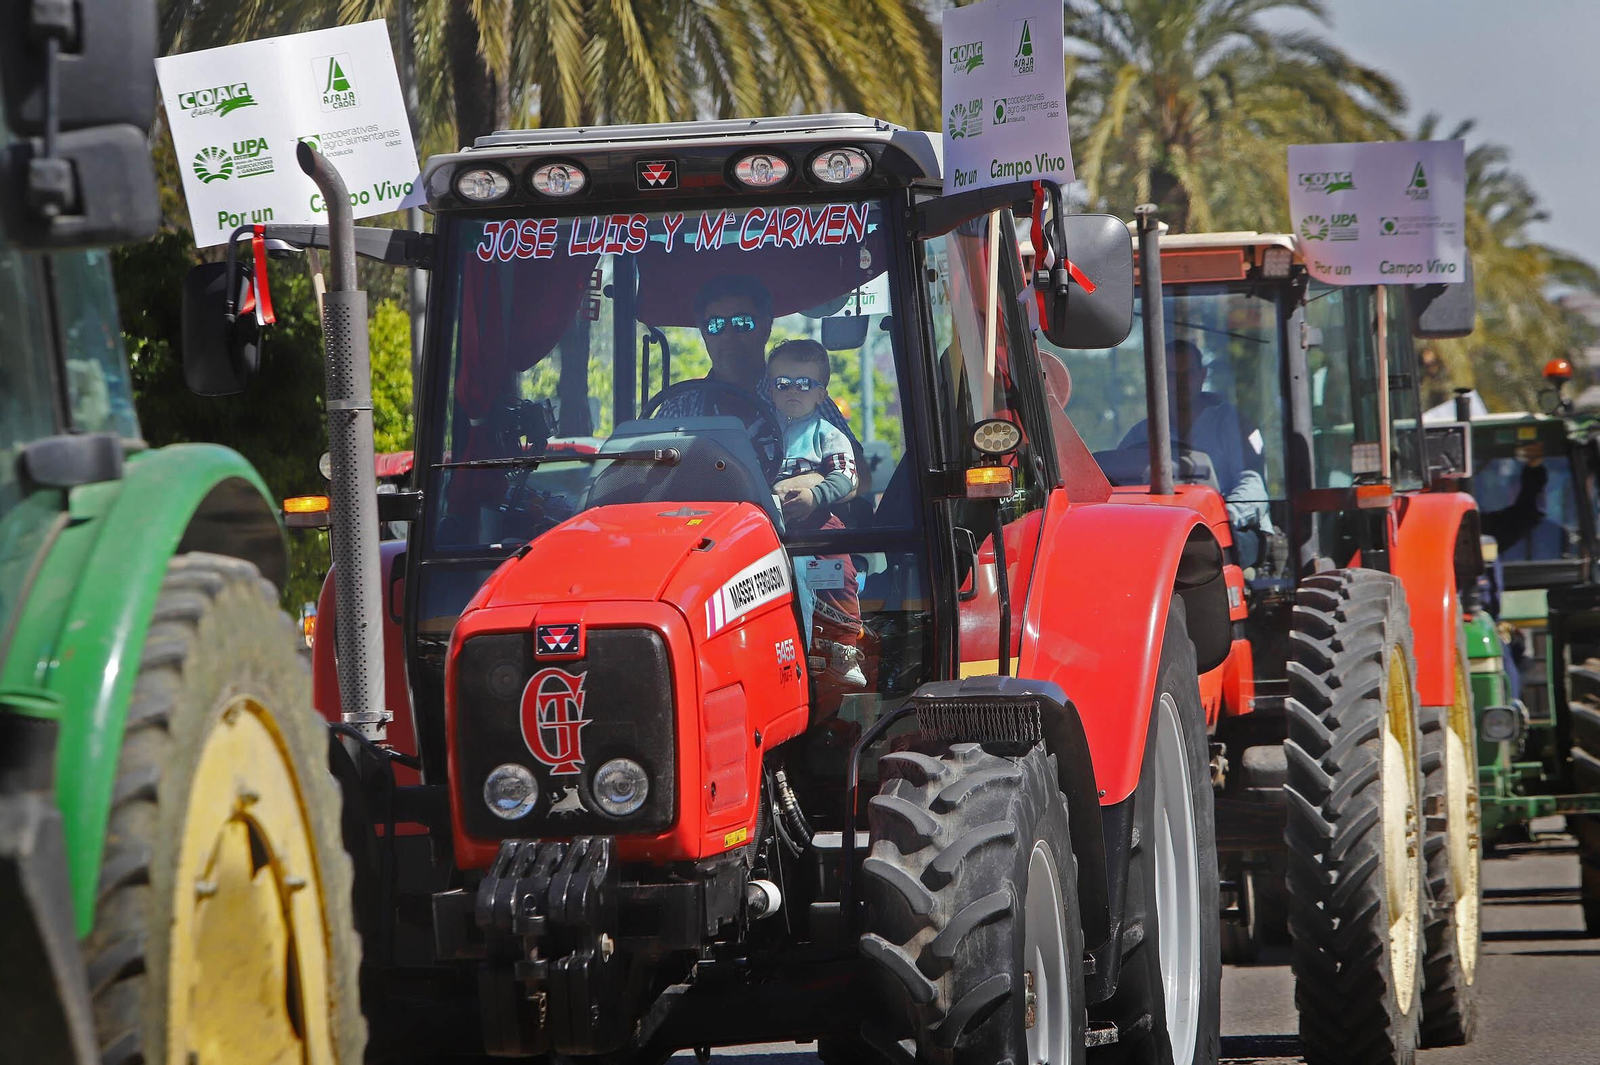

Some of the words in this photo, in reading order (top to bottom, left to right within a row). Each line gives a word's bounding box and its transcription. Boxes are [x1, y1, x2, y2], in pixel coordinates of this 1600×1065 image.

[950, 41, 982, 65] COAG
[1013, 57, 1034, 69] ASAJA
[178, 83, 250, 110] COAG
[322, 91, 355, 104] ASAJA
[1007, 93, 1045, 105] cooperativas
[968, 98, 983, 116] UPA
[1007, 100, 1059, 115] agro-alimentarias
[321, 124, 379, 141] cooperativas
[323, 129, 401, 150] agro-alimentarias
[233, 137, 269, 157] UPA
[954, 168, 968, 188] Por
[968, 169, 978, 185] un
[990, 158, 1033, 182] Campo
[1034, 152, 1066, 174] Vivo
[1299, 172, 1353, 187] COAG
[373, 180, 414, 202] Vivo
[218, 211, 247, 230] Por
[251, 207, 274, 224] un
[1331, 213, 1358, 228] UPA
[477, 218, 558, 262] JOSE
[568, 213, 649, 257] LUIS
[663, 212, 684, 254] Y
[738, 202, 870, 252] CARMEN
[1315, 261, 1332, 275] Por
[1335, 264, 1351, 275] un
[1379, 259, 1423, 278] Campo
[1427, 258, 1457, 274] Vivo
[862, 294, 876, 305] un
[729, 576, 758, 610] MASSEY
[753, 565, 785, 598] FERGUSON
[774, 638, 796, 665] 5455
